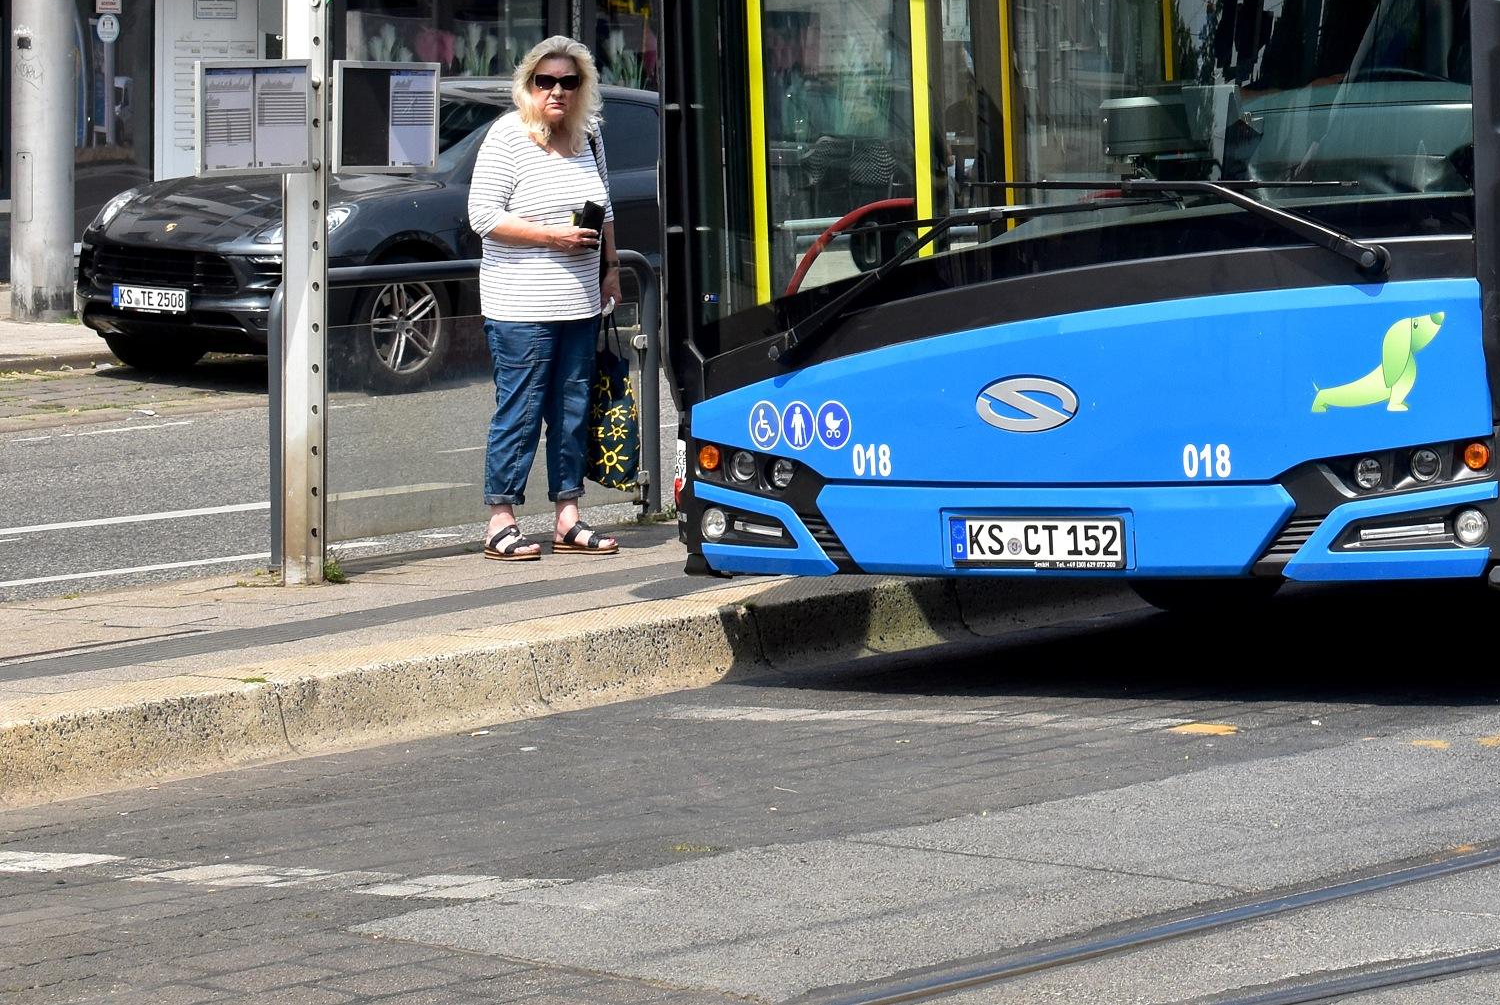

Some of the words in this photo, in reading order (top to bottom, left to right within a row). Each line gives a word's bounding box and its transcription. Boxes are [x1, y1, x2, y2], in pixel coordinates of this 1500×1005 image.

[120, 288, 132, 304] KS
[141, 290, 154, 306] TE
[157, 292, 184, 308] 2508
[852, 443, 891, 477] 018
[1182, 443, 1232, 478] 018
[968, 524, 1005, 555] KS
[1024, 524, 1058, 556] CT
[1067, 524, 1118, 556] 152
